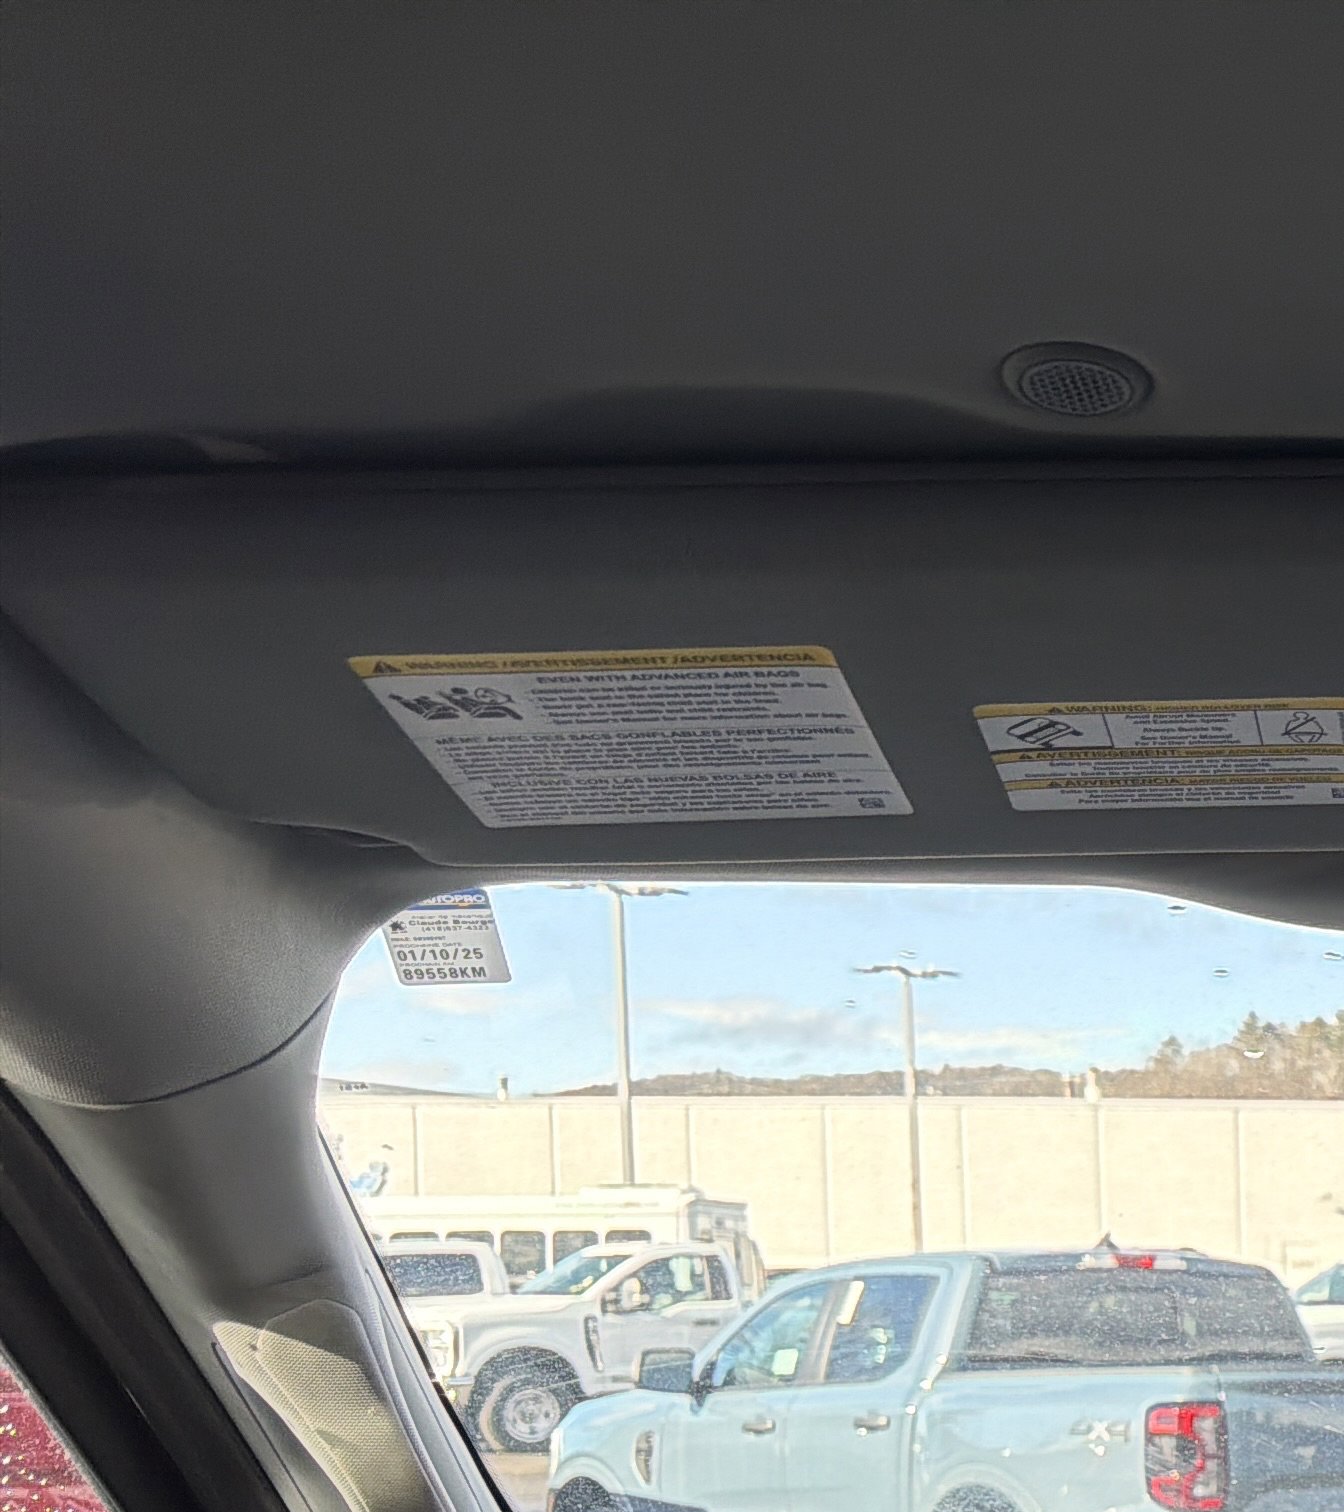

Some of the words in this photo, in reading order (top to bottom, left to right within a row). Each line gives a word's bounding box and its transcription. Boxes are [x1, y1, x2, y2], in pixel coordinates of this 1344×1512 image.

[537, 674, 582, 684] EVEN
[587, 673, 626, 683] WITH
[631, 671, 720, 681] ADVANCED
[754, 669, 800, 679] BAGS
[568, 732, 612, 741] SACS
[396, 947, 484, 961] 01/10/25
[402, 966, 487, 980] 89558KM
